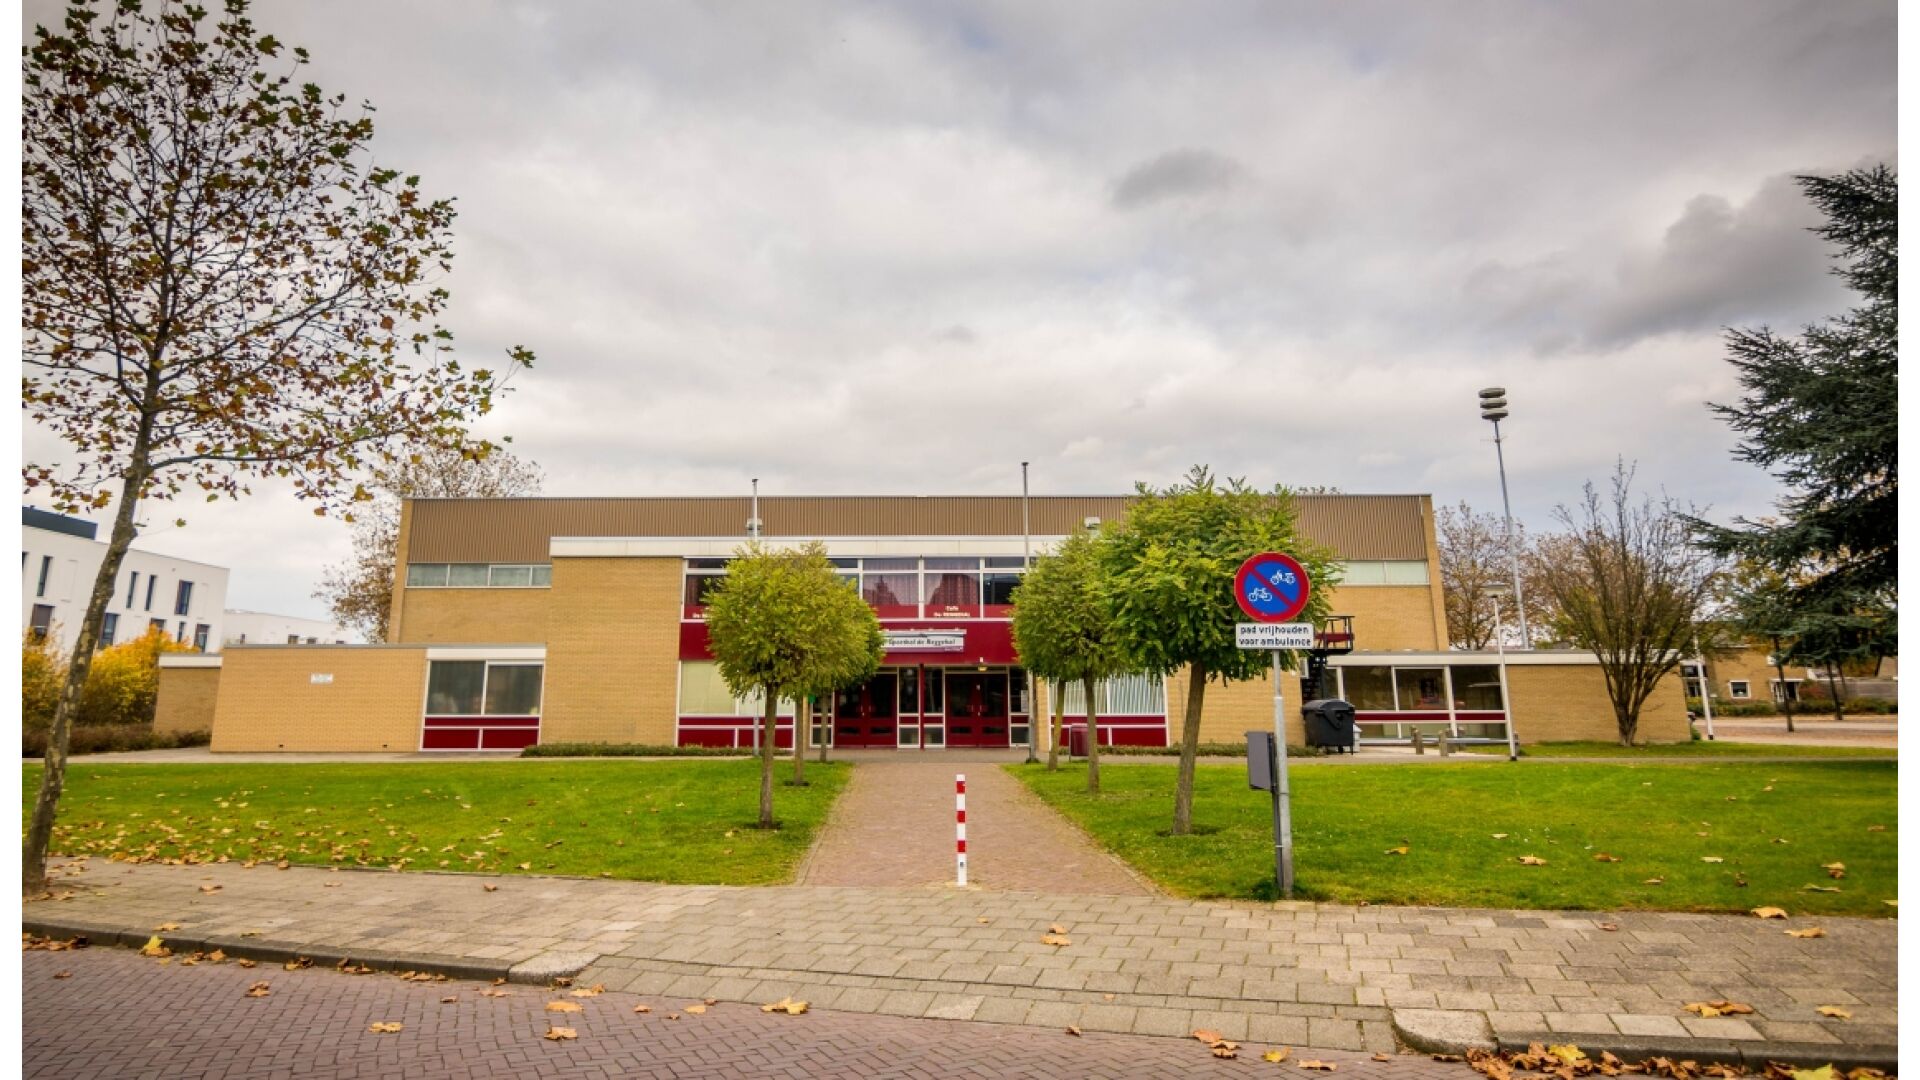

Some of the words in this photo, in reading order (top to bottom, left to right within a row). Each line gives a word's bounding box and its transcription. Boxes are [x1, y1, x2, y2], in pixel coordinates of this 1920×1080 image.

[1240, 625, 1257, 635] pad
[1258, 625, 1309, 637] vrijhouden
[1239, 638, 1259, 646] voor
[1260, 637, 1311, 646] ambulance
